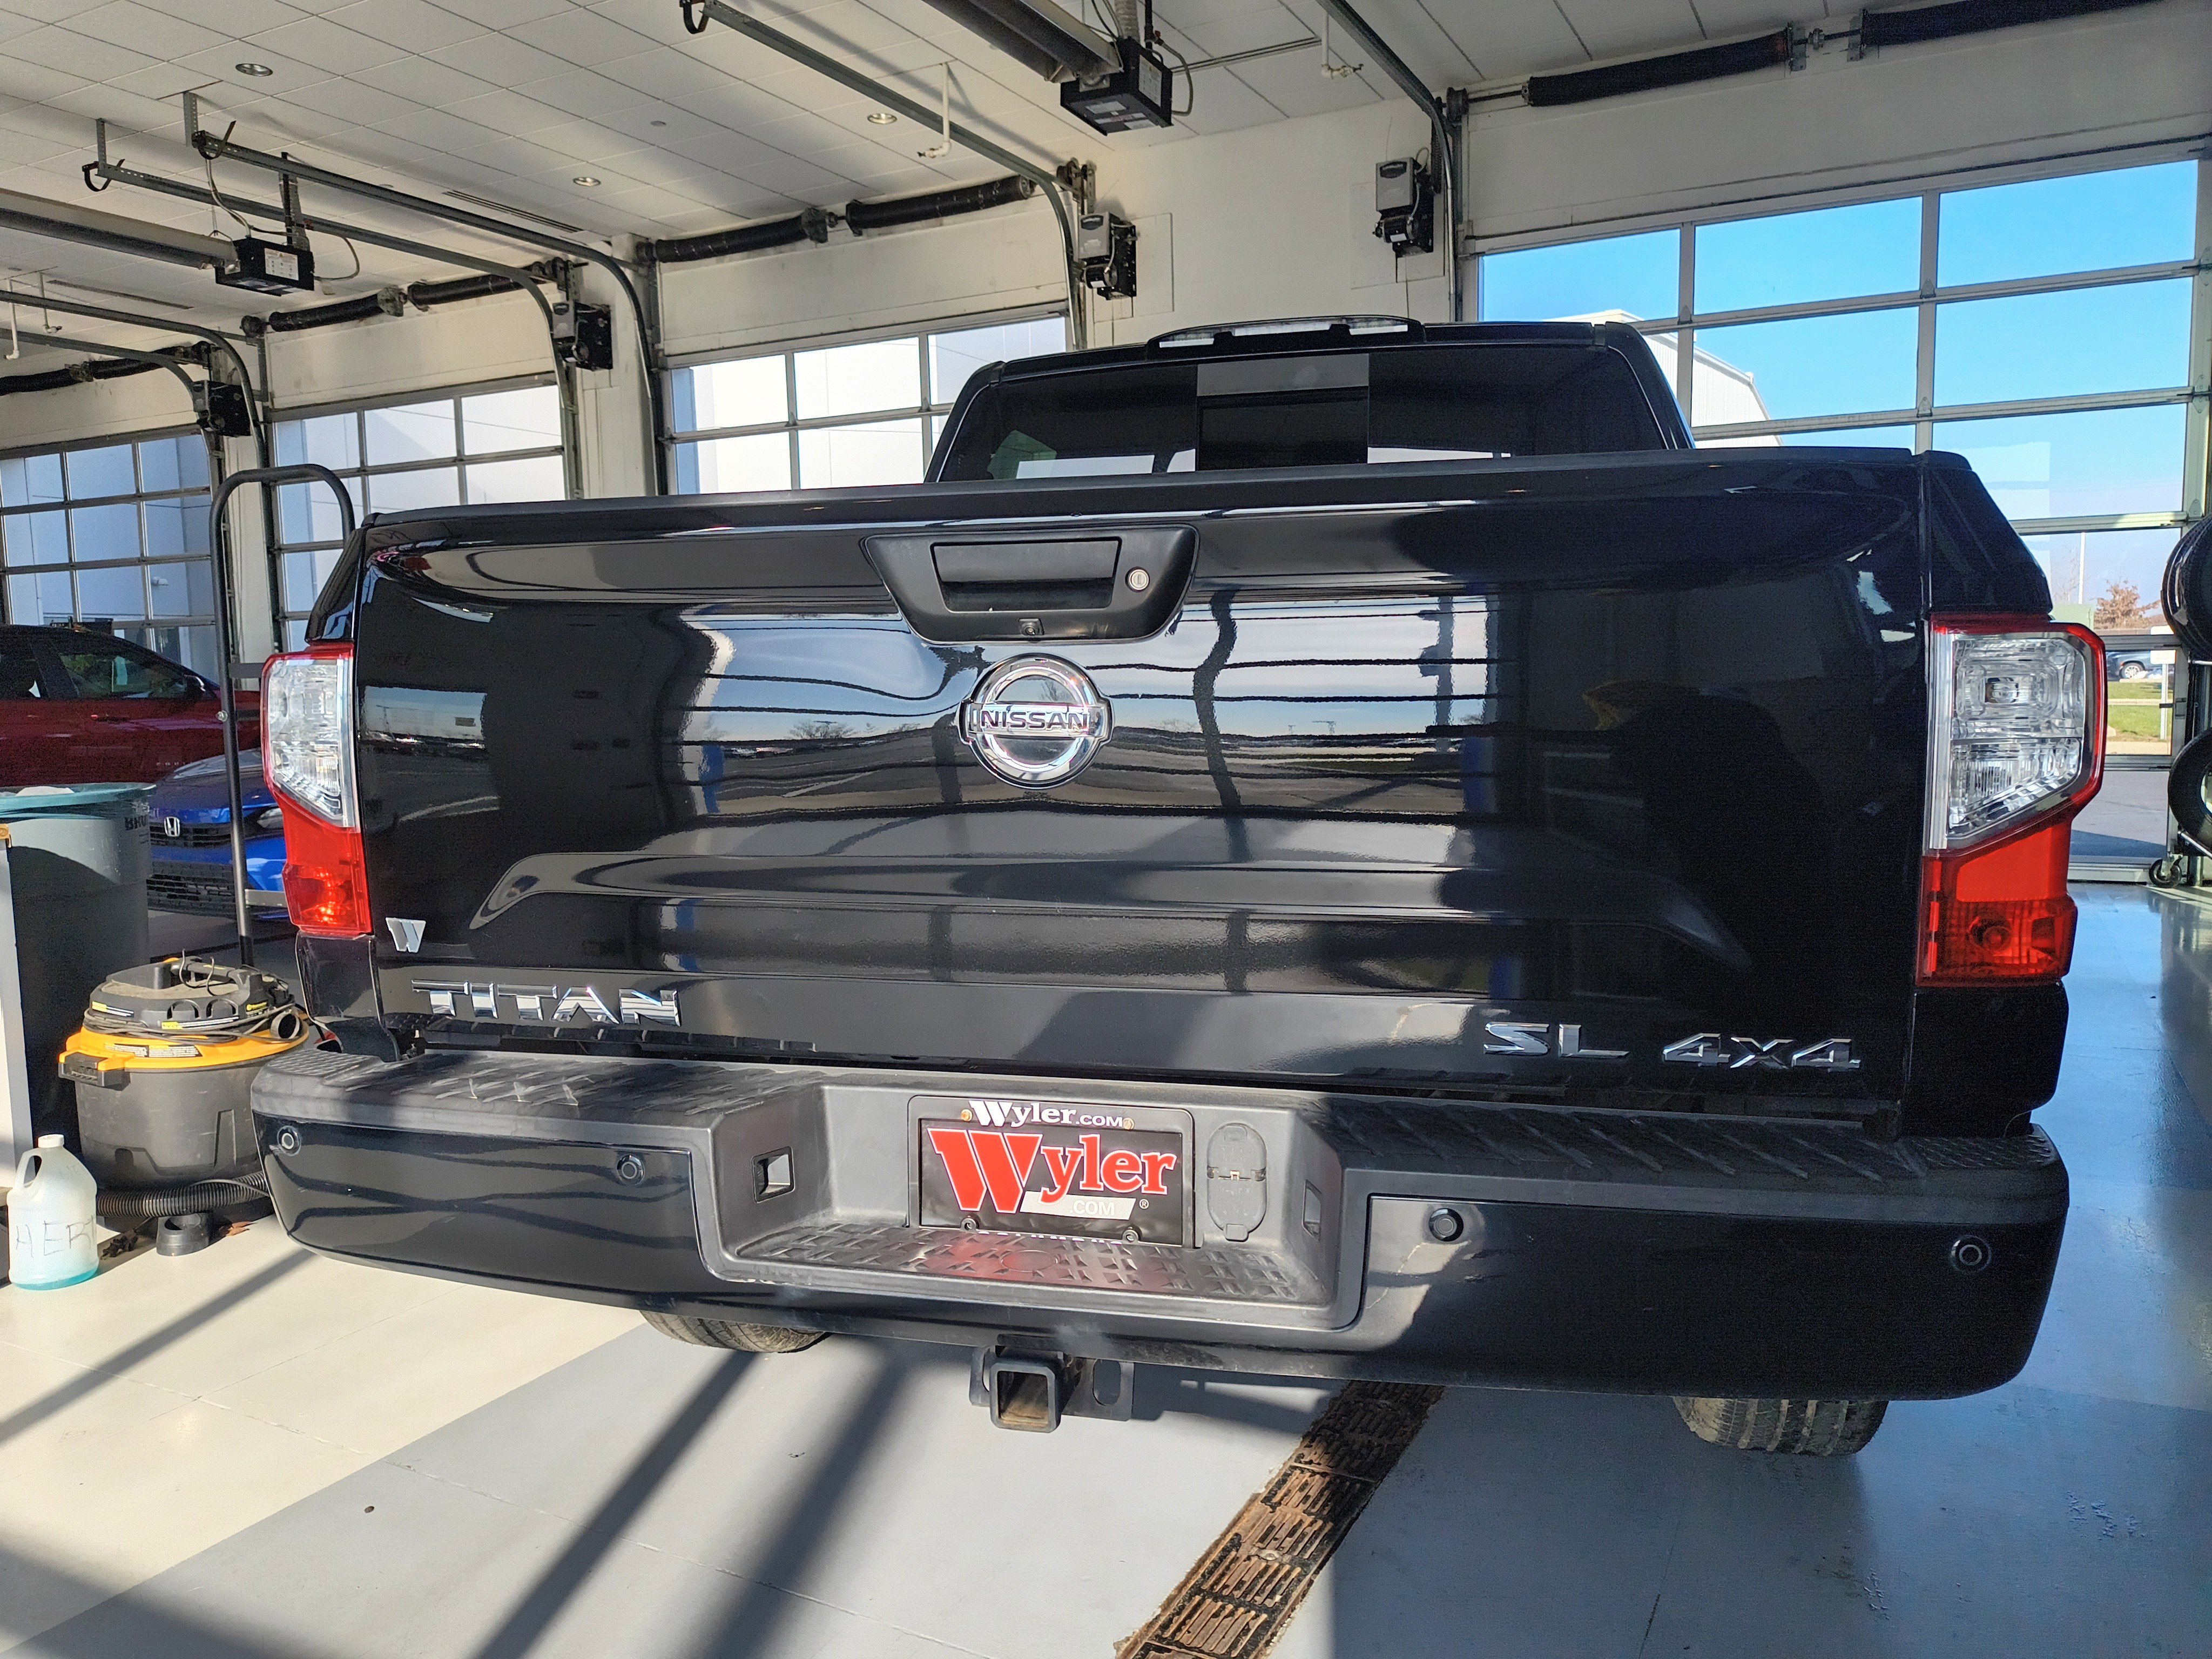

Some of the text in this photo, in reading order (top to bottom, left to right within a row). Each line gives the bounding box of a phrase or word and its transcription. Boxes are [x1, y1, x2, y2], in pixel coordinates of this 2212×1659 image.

[981, 710, 1089, 731] NISSAN
[411, 979, 682, 1027] TITAN
[1483, 1021, 1630, 1057] SL
[927, 1128, 1177, 1214] Wyler
